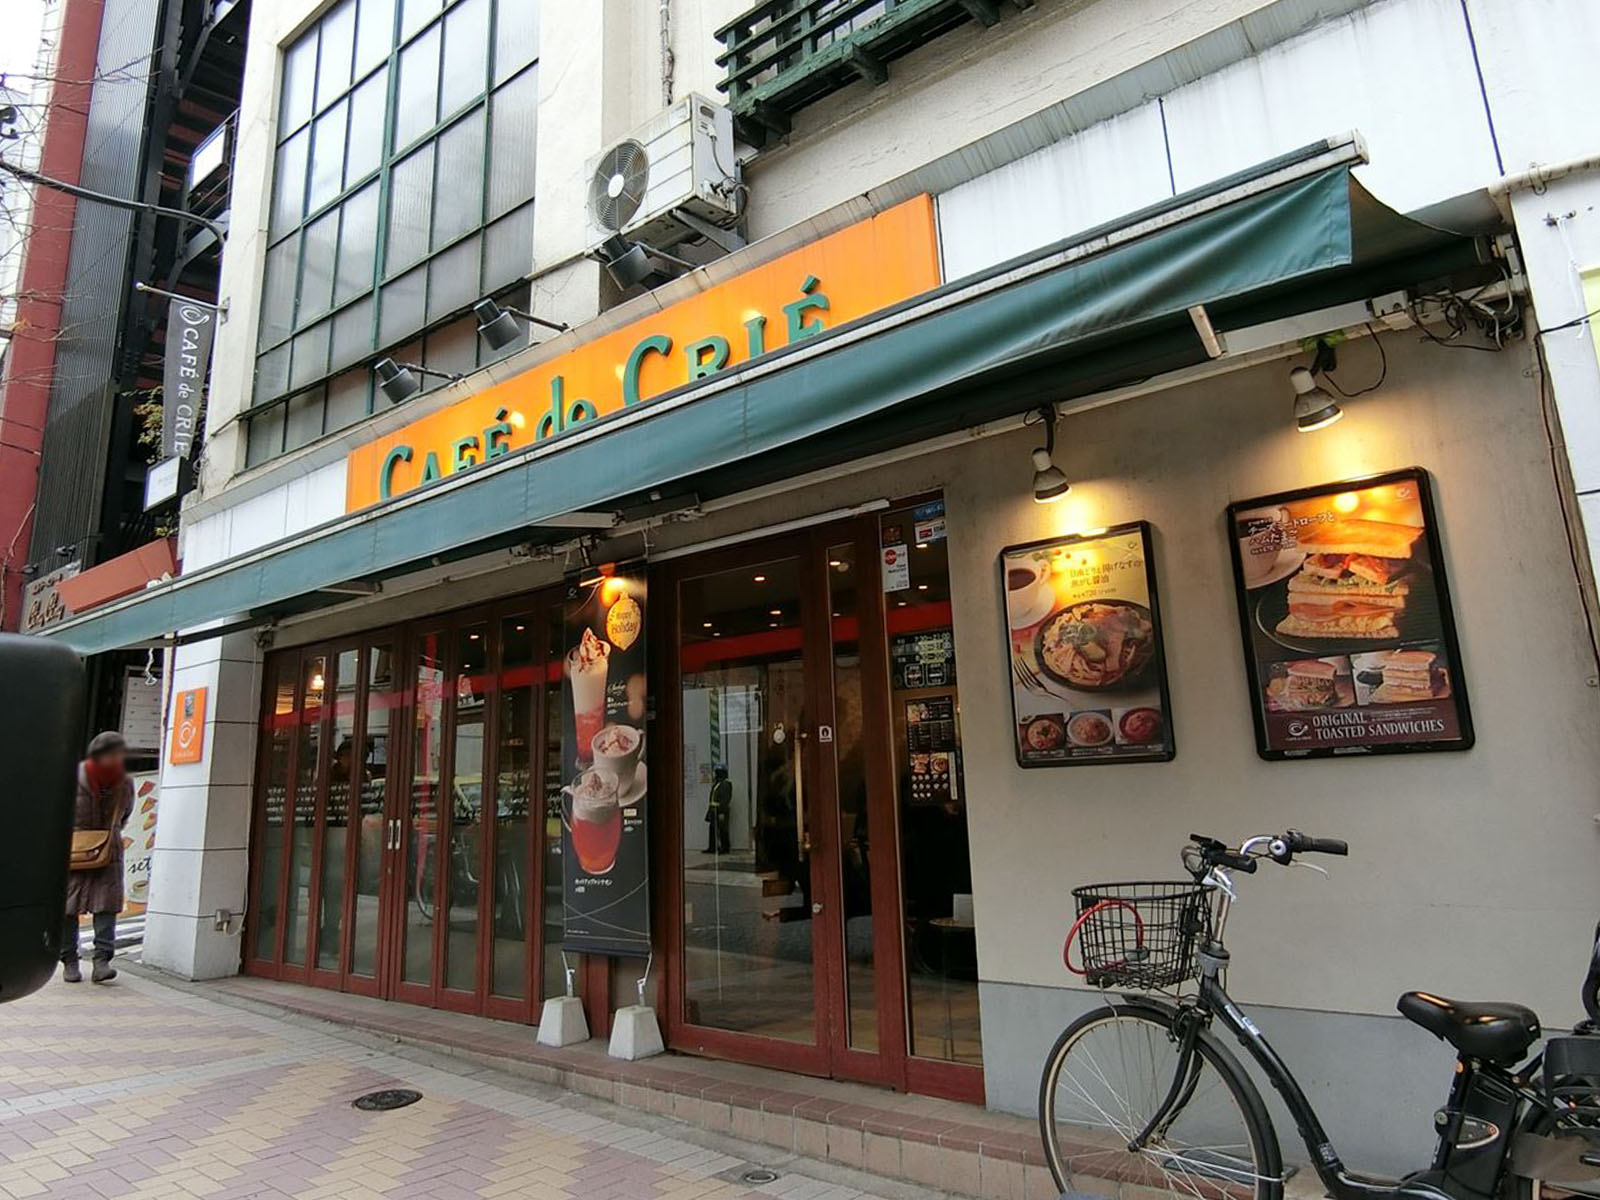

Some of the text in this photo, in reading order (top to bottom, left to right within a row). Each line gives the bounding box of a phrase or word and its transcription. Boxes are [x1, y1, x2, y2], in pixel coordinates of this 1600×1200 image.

[180, 328, 200, 379] CAFÉ
[178, 383, 195, 399] de
[380, 275, 830, 500] CAFÉ de CRIÉ
[1312, 711, 1368, 728] ORIGINAL
[1315, 719, 1445, 740] TOASTED SANDWICHES
